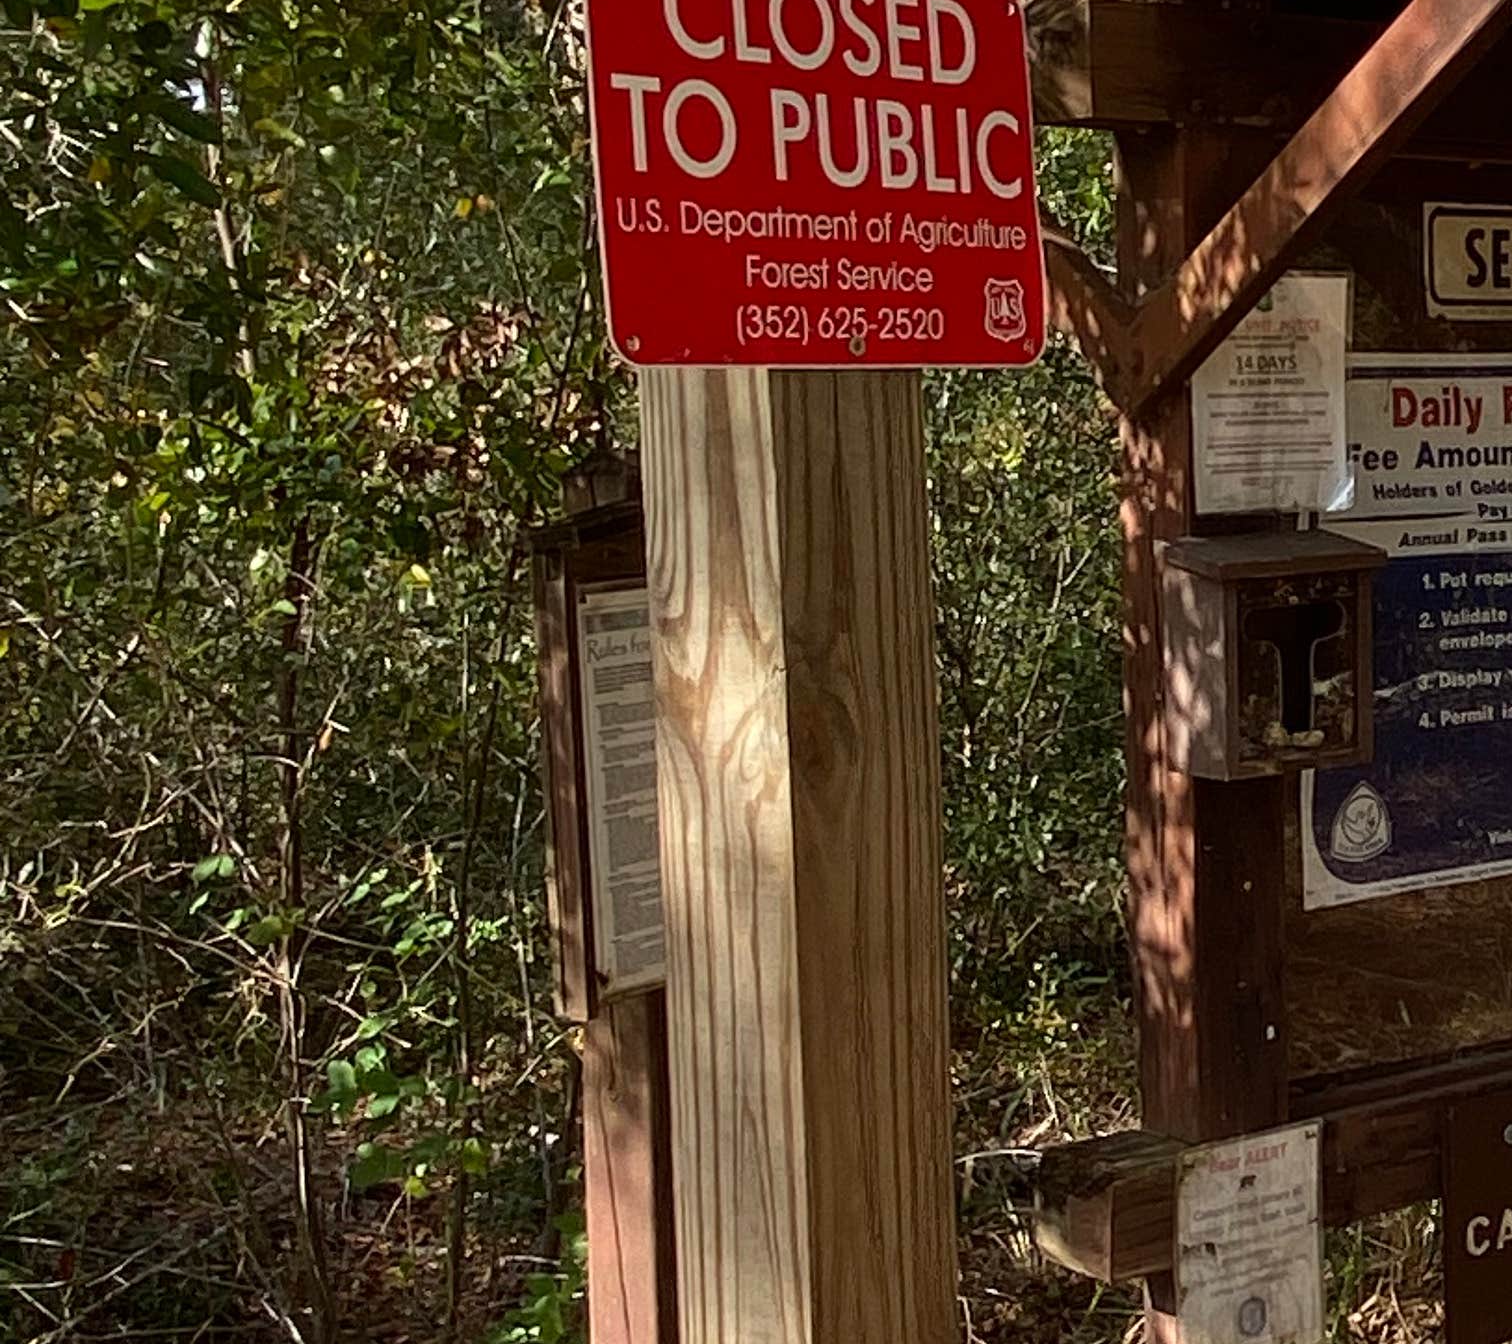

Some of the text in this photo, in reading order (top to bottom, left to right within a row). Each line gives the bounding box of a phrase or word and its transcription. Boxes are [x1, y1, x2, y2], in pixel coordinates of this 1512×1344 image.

[610, 72, 1023, 200] TO PUBLIC
[615, 197, 1027, 253] U.S. Department of Agriculture
[745, 254, 934, 293] Forest Service
[736, 306, 945, 346] (352) 625-2520
[1257, 354, 1297, 371] DAYS
[1391, 383, 1483, 433] Daily
[1373, 482, 1438, 500] Holders
[1445, 480, 1462, 497] of
[1476, 502, 1508, 519] Pay
[1398, 529, 1459, 548] Annual
[1466, 527, 1507, 544] Pass
[1422, 573, 1436, 590] 1.
[1439, 571, 1468, 589] Put
[1418, 611, 1436, 629] 2.
[1440, 607, 1508, 627] Validate
[1438, 668, 1502, 690] Display
[1418, 711, 1437, 729] 4.
[1440, 705, 1495, 727] Permit
